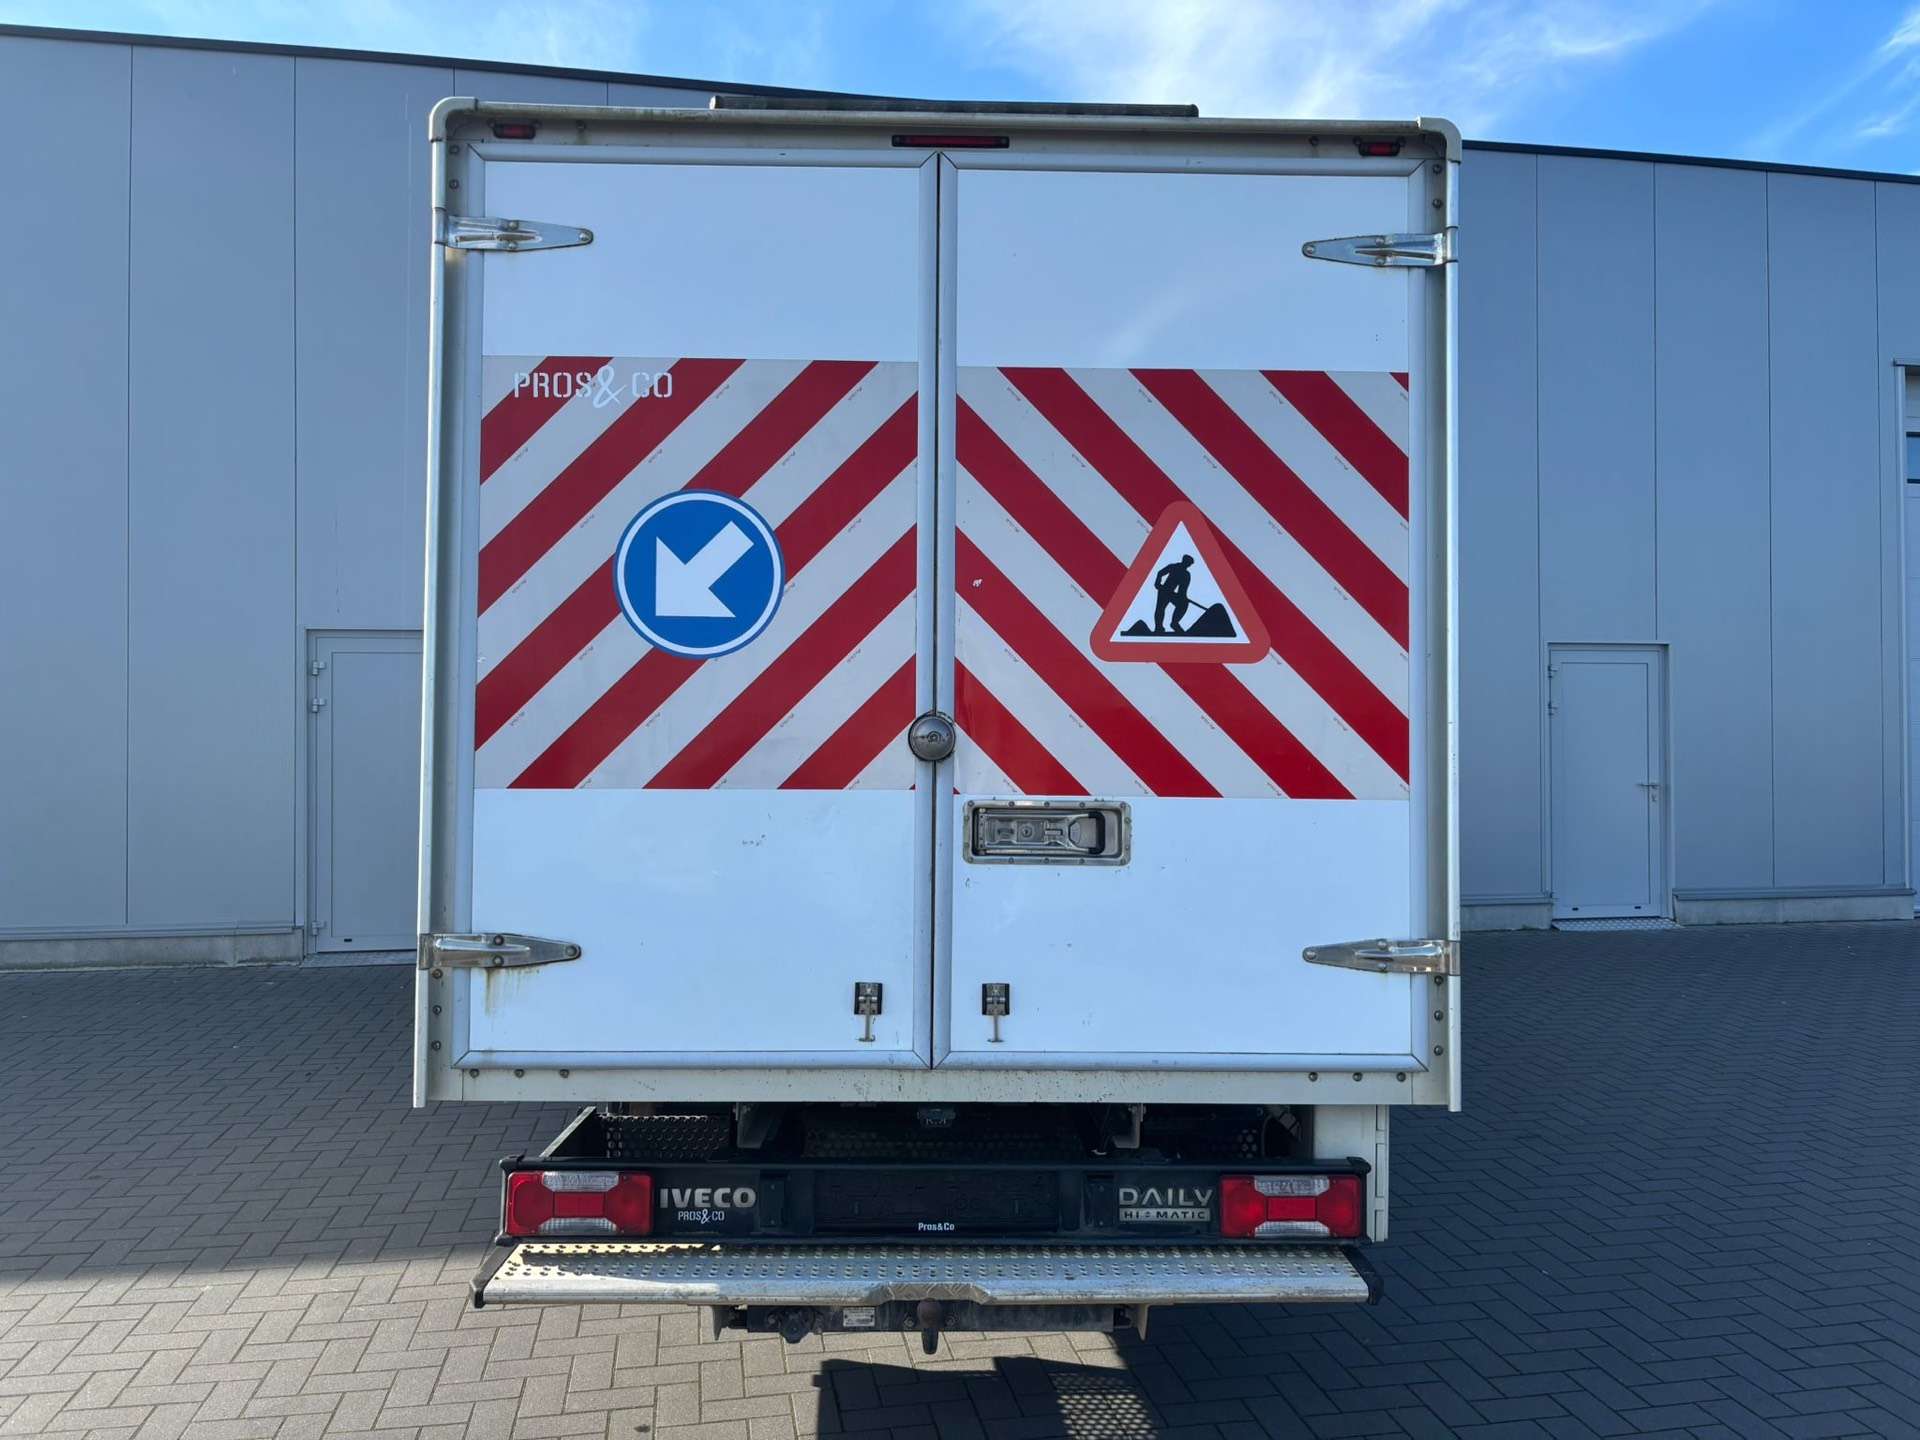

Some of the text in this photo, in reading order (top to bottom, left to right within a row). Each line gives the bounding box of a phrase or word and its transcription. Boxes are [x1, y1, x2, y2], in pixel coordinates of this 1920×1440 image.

[660, 1188, 756, 1208] IVECO
[1119, 1188, 1213, 1206] DAILY
[918, 1222, 955, 1231] Pros&Co
